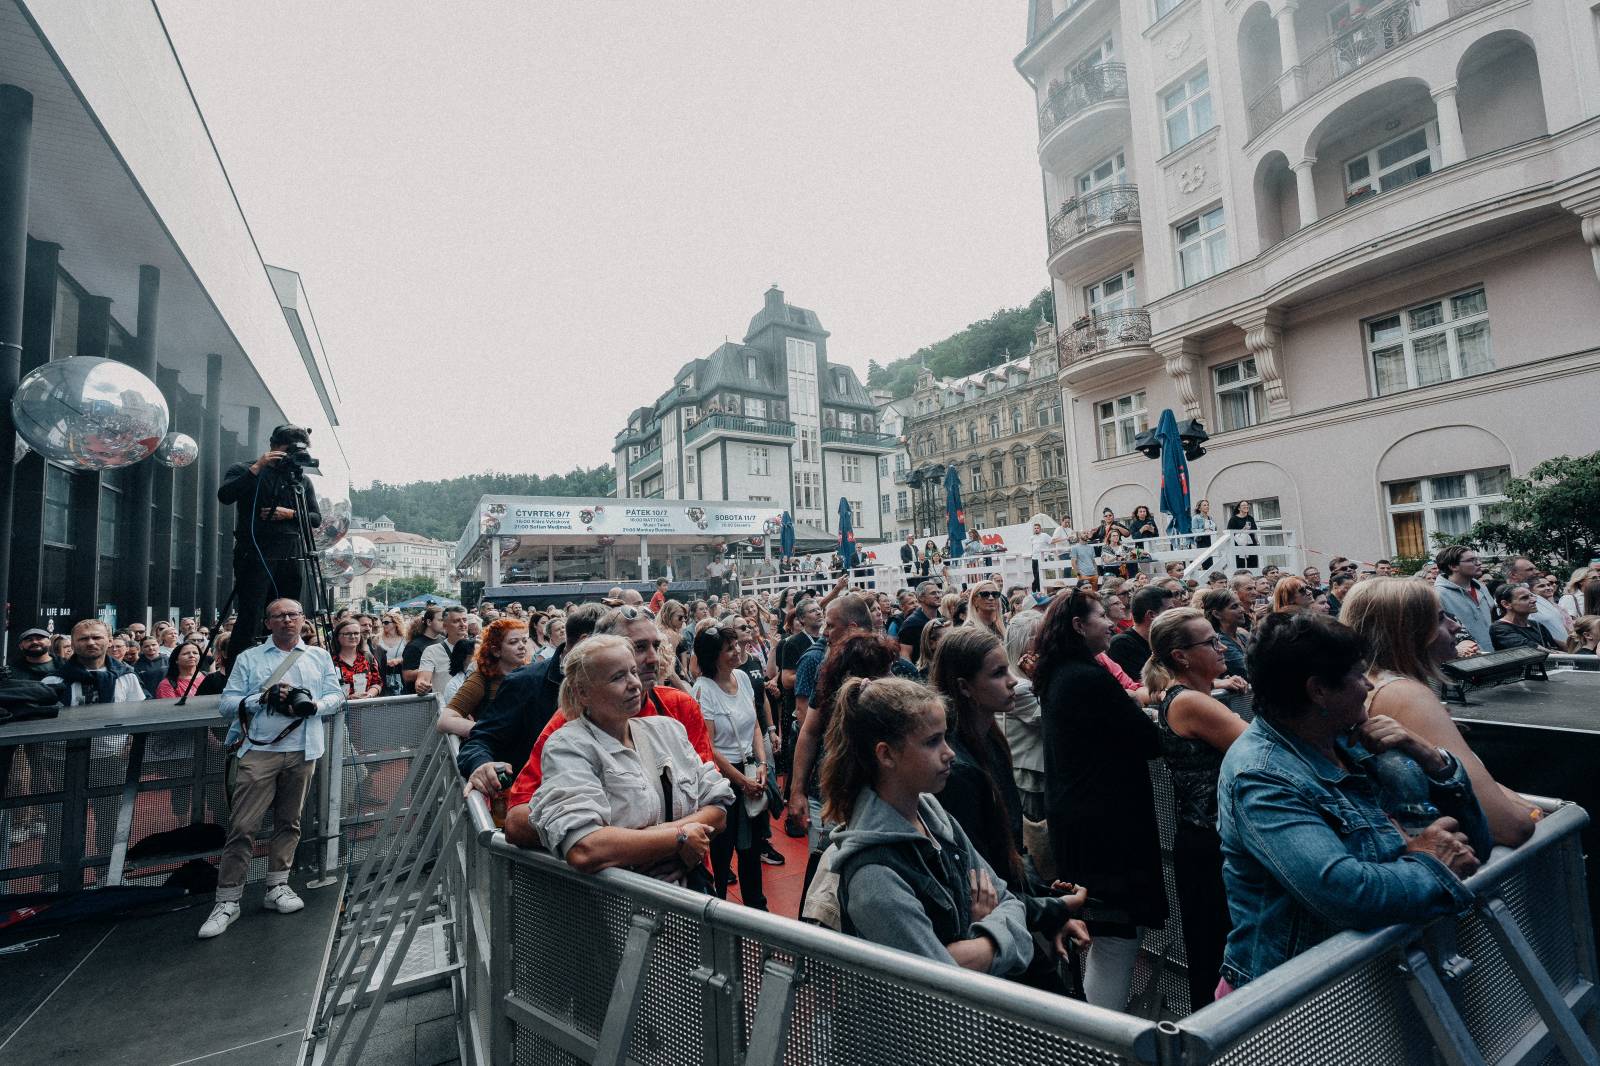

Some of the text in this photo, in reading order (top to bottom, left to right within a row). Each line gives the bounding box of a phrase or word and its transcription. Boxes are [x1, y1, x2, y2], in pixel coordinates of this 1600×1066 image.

[515, 509, 554, 517] ČTVRTEK
[46, 608, 58, 616] LIFE
[60, 608, 71, 616] BAR
